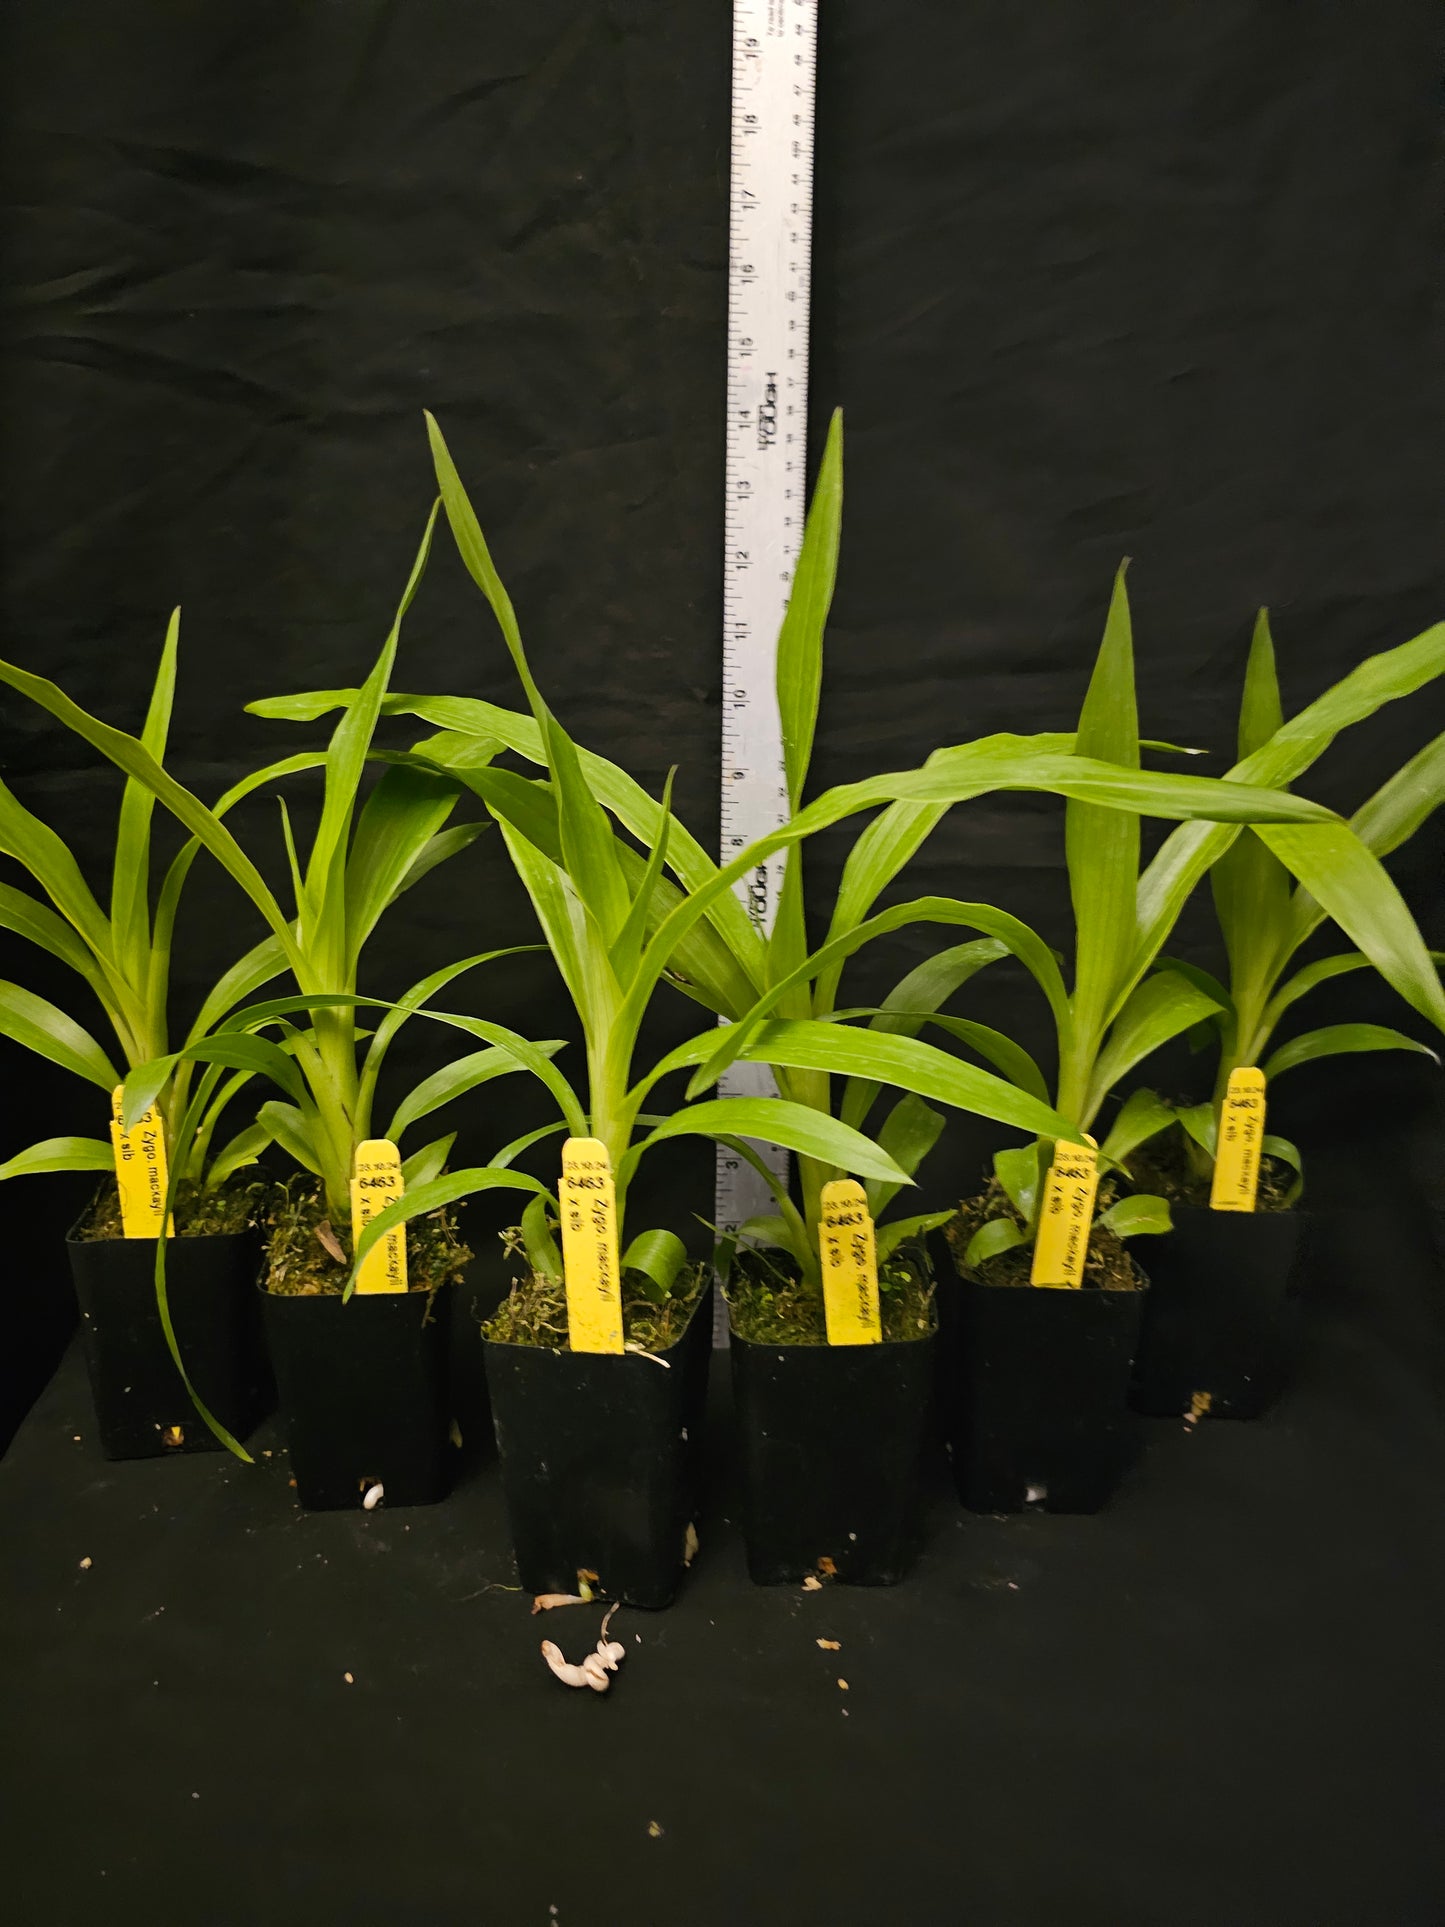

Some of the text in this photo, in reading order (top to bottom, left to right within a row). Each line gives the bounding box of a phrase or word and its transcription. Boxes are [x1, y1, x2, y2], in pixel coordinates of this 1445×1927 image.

[744, 38, 759, 60] 19
[743, 114, 758, 136] 18
[741, 189, 756, 212] 17
[741, 264, 755, 285] 16
[740, 338, 753, 357] 15
[739, 411, 751, 431] 14
[737, 479, 751, 500] 13
[735, 551, 749, 570] 12
[734, 622, 748, 640] 11
[733, 689, 746, 709] 10
[731, 838, 744, 846] 8
[142, 1130, 165, 1217] Zygo. mackayii
[725, 1161, 739, 1169] 3
[1055, 1166, 1090, 1180] 6463
[359, 1175, 396, 1189] 6463
[567, 1176, 605, 1189] 6463
[725, 1224, 738, 1233] 2
[825, 1212, 864, 1229] 6463
[386, 1233, 403, 1286] mackayii
[591, 1199, 615, 1302] Zygo. mackayii
[851, 1233, 868, 1269] Zygo.
